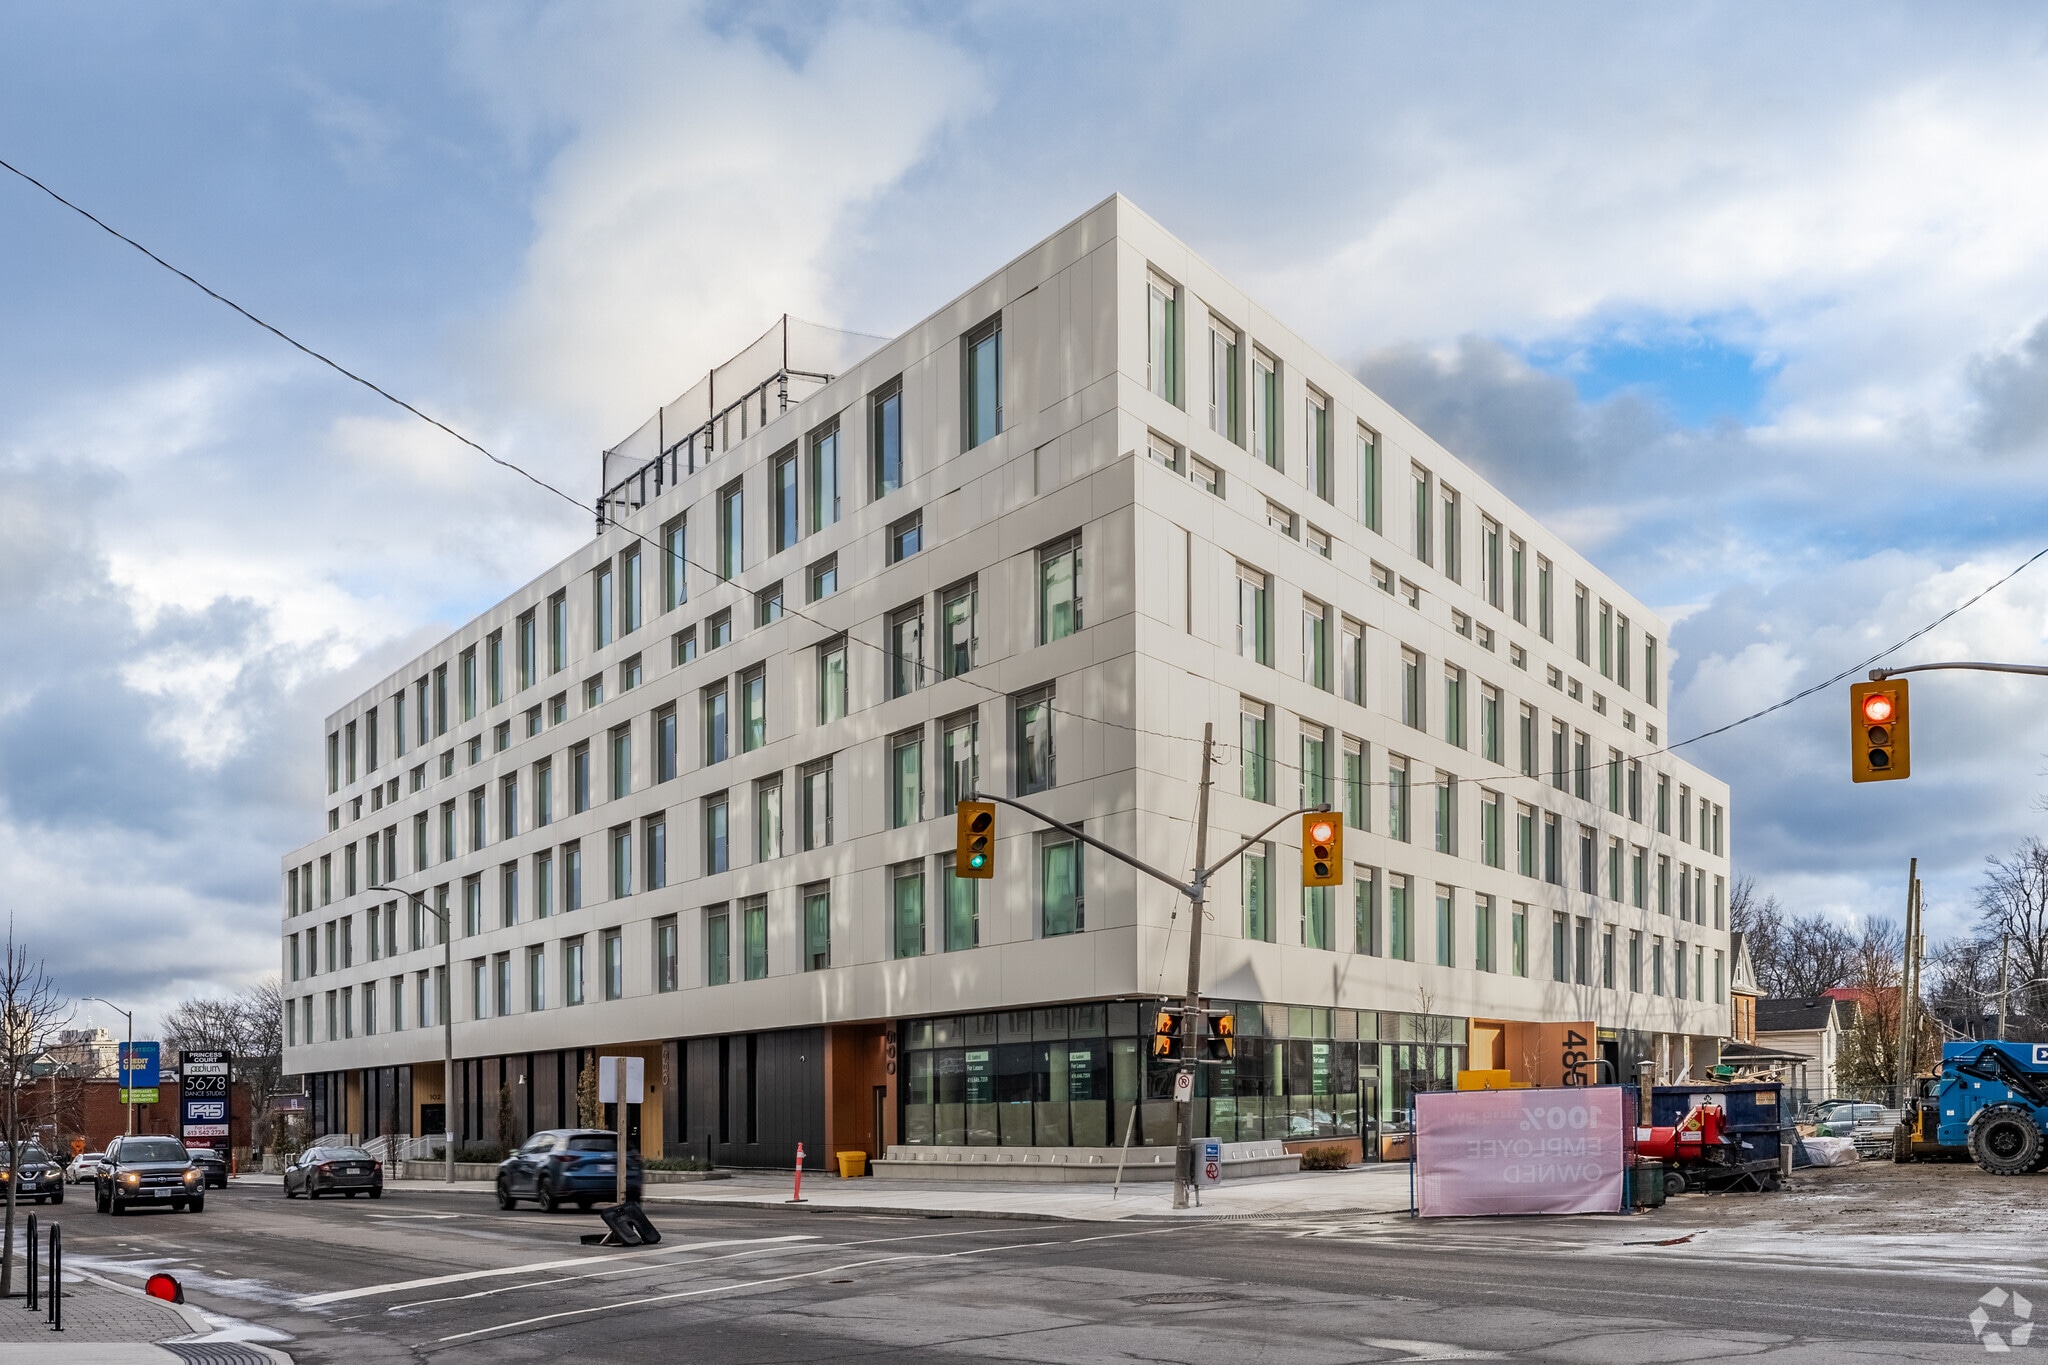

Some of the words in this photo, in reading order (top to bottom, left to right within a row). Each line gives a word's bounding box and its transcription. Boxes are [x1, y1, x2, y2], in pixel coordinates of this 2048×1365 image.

[886, 1030, 896, 1075] 500
[1562, 1030, 1588, 1087] 485
[190, 1064, 221, 1074] podium
[185, 1076, 226, 1090] 5678
[189, 1103, 223, 1118] F45
